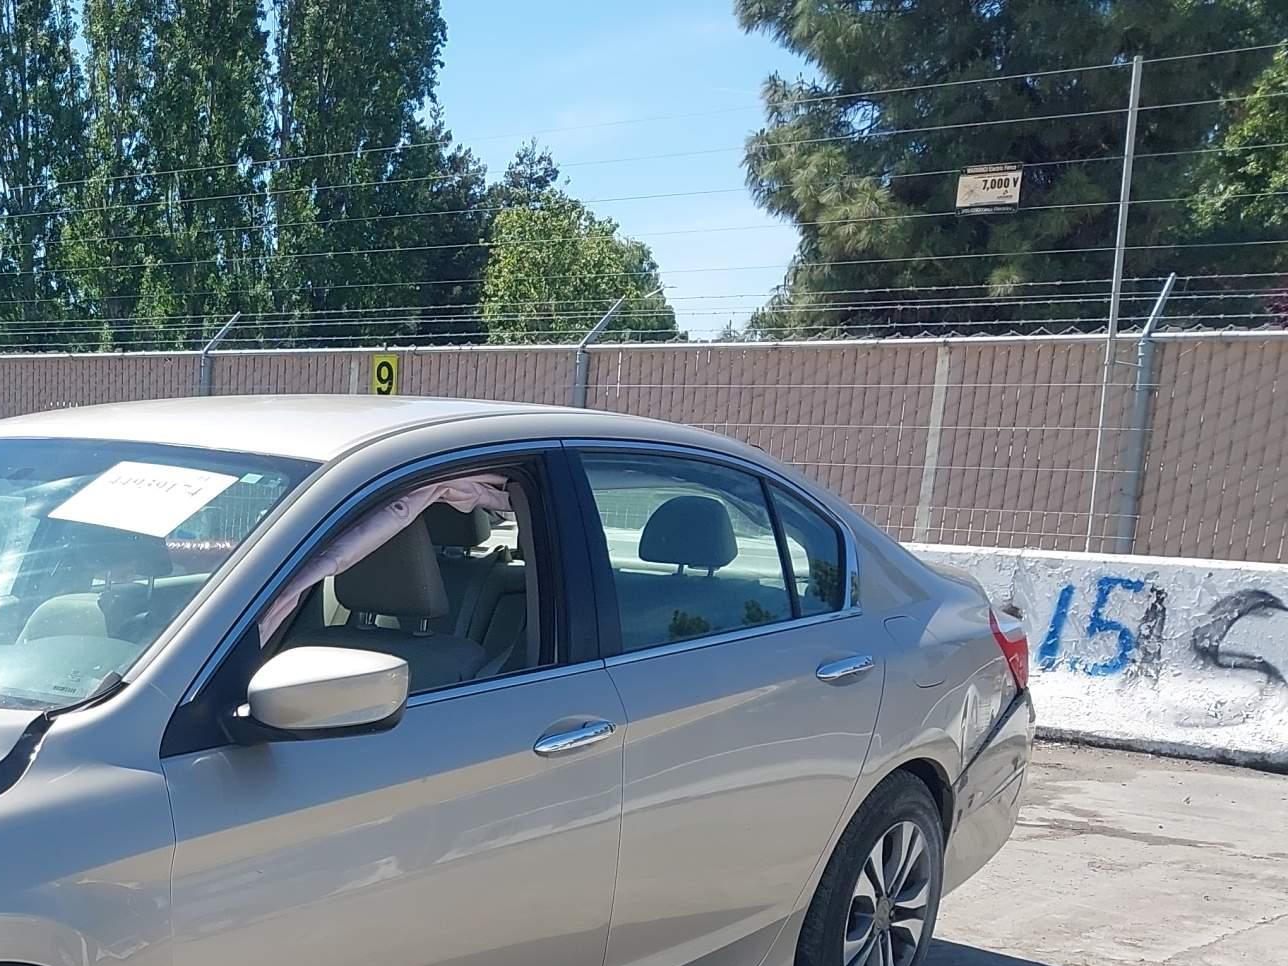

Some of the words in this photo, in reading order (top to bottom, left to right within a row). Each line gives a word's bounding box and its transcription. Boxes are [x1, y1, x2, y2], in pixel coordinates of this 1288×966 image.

[982, 178, 1010, 191] 7,000
[1012, 177, 1019, 188] V
[376, 360, 394, 395] 9
[1035, 576, 1145, 678] 15
